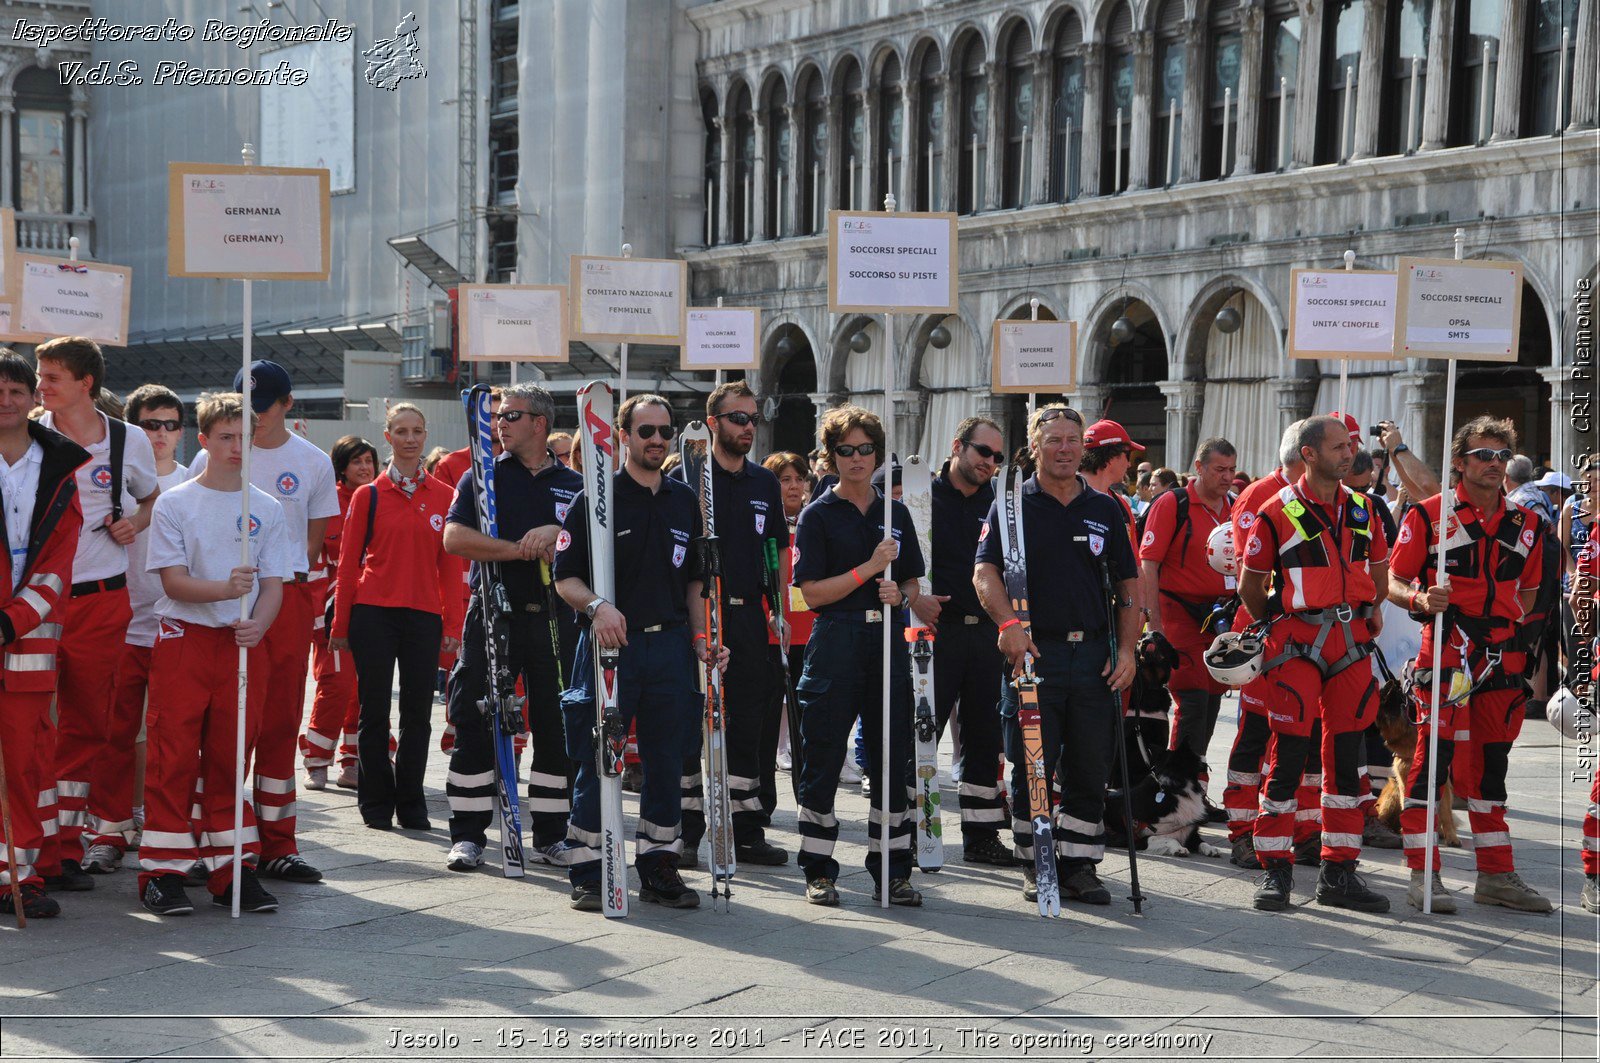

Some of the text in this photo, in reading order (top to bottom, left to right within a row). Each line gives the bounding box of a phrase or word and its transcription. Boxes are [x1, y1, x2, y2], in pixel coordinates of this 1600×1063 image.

[224, 207, 282, 216] GERMANIA
[223, 234, 284, 244] (GERMANY)
[850, 246, 938, 255] SOCCORSI SPECIALI
[849, 270, 896, 279] SOCCORSO
[912, 272, 938, 280] PISTE
[57, 288, 90, 298] OLANDA
[586, 288, 674, 298] COMITATO NAZIONALE
[1307, 298, 1348, 306] SOCCORSI
[1420, 293, 1502, 304] SOCCORSI SPECIALI
[40, 304, 104, 320] (NETHERLANDS)
[608, 306, 652, 315] FEMMINILE
[1342, 321, 1380, 329] CINOFILE
[1448, 318, 1471, 327] OPSA
[1447, 331, 1470, 339] SMTS
[478, 391, 500, 540] ATOMIC
[594, 443, 608, 529] NORDICA
[703, 464, 715, 534] DYNAFIT
[605, 829, 615, 910] DOBERMANN
[614, 886, 623, 911] GS
